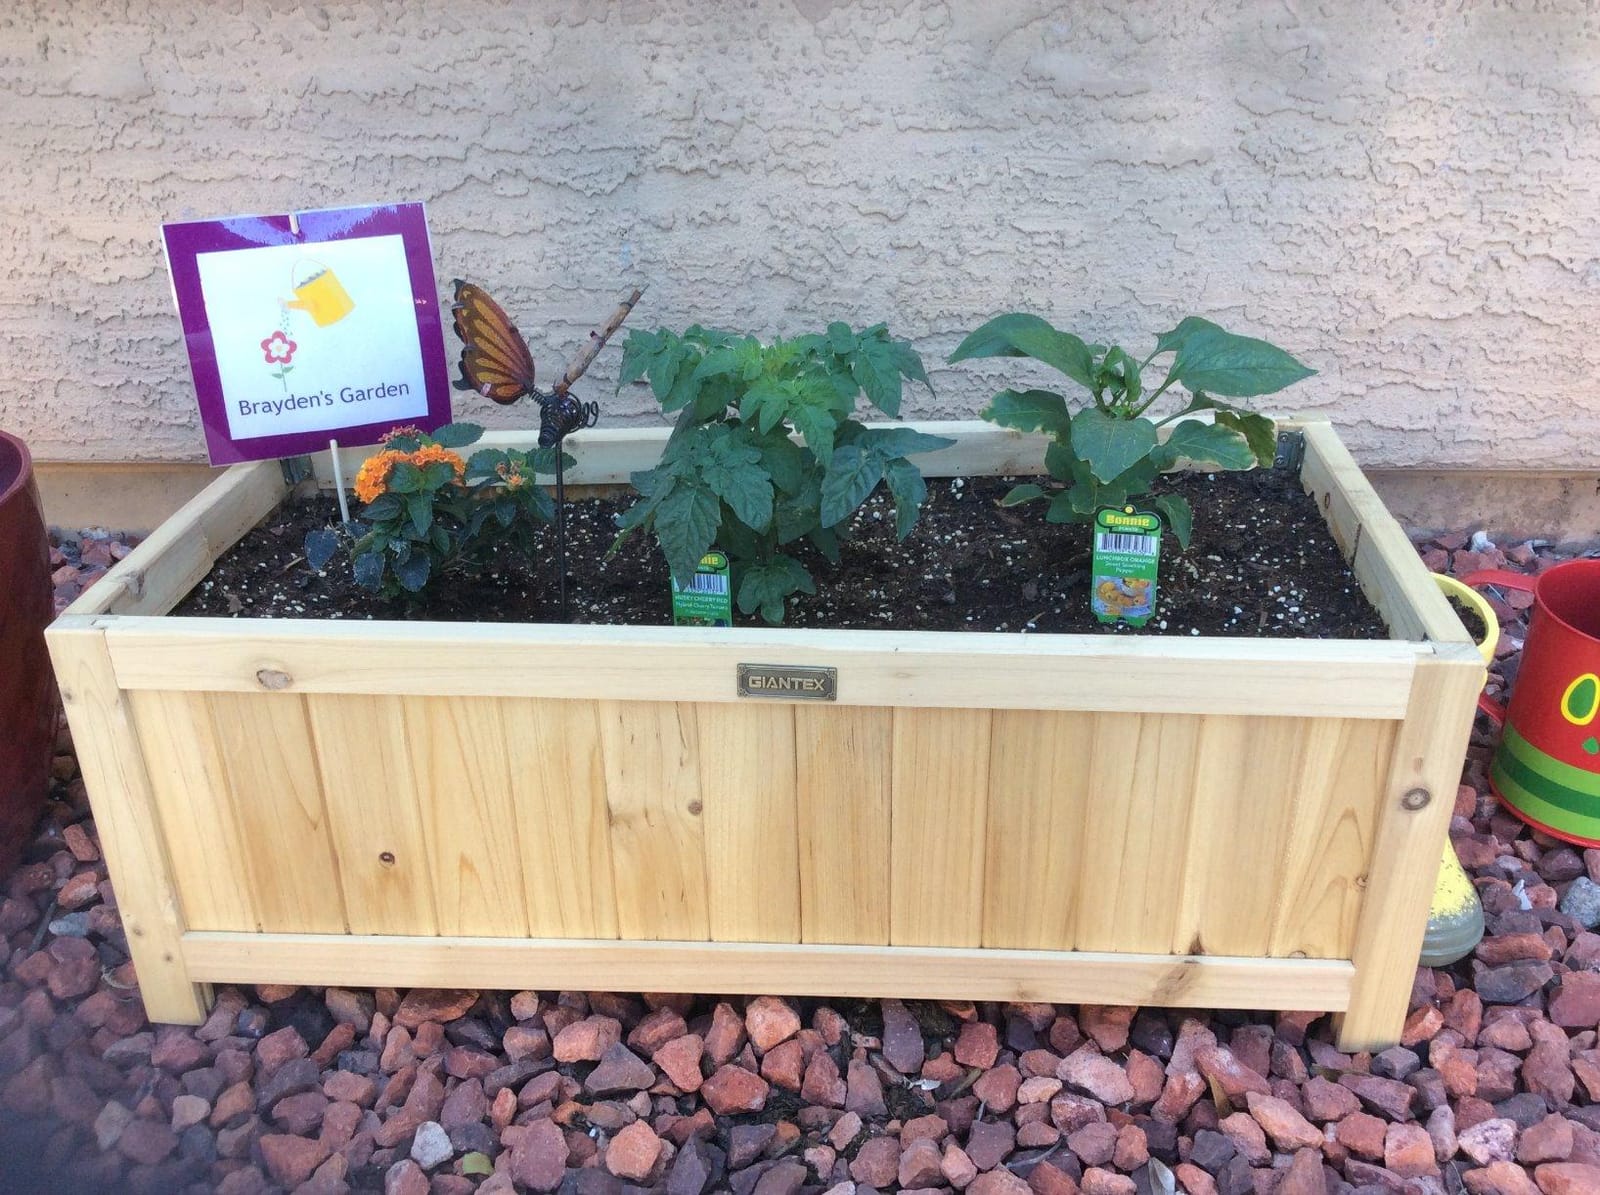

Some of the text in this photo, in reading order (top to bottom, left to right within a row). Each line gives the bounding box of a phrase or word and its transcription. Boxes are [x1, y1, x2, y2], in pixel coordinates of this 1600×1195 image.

[239, 382, 409, 416] Brayden's Garden
[1105, 514, 1150, 527] Bonnie
[748, 675, 825, 691] GIANTEX
